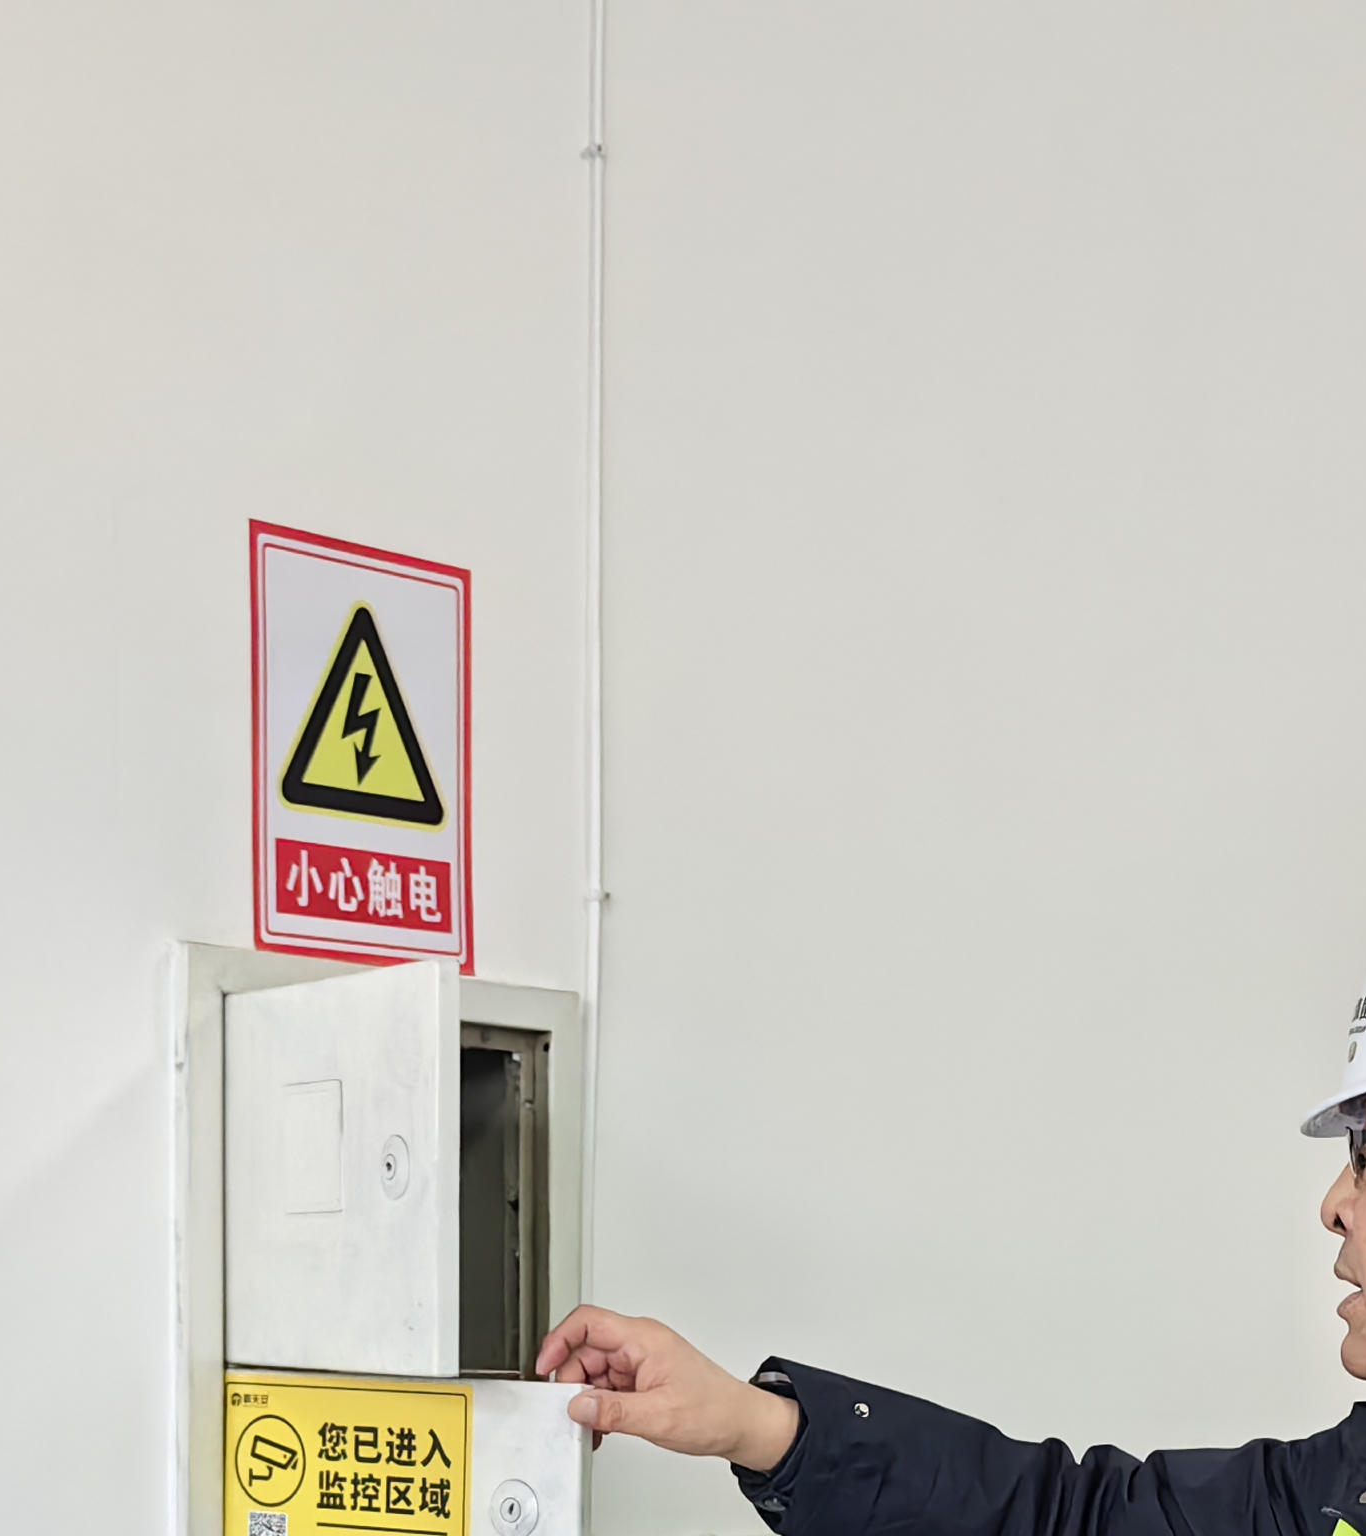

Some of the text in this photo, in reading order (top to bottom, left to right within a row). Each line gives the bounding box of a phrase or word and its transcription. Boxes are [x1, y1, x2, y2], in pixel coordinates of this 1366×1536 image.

[286, 849, 443, 923] 小心触电
[317, 1421, 452, 1469] 您已进入
[316, 1469, 451, 1519] 监控区域
